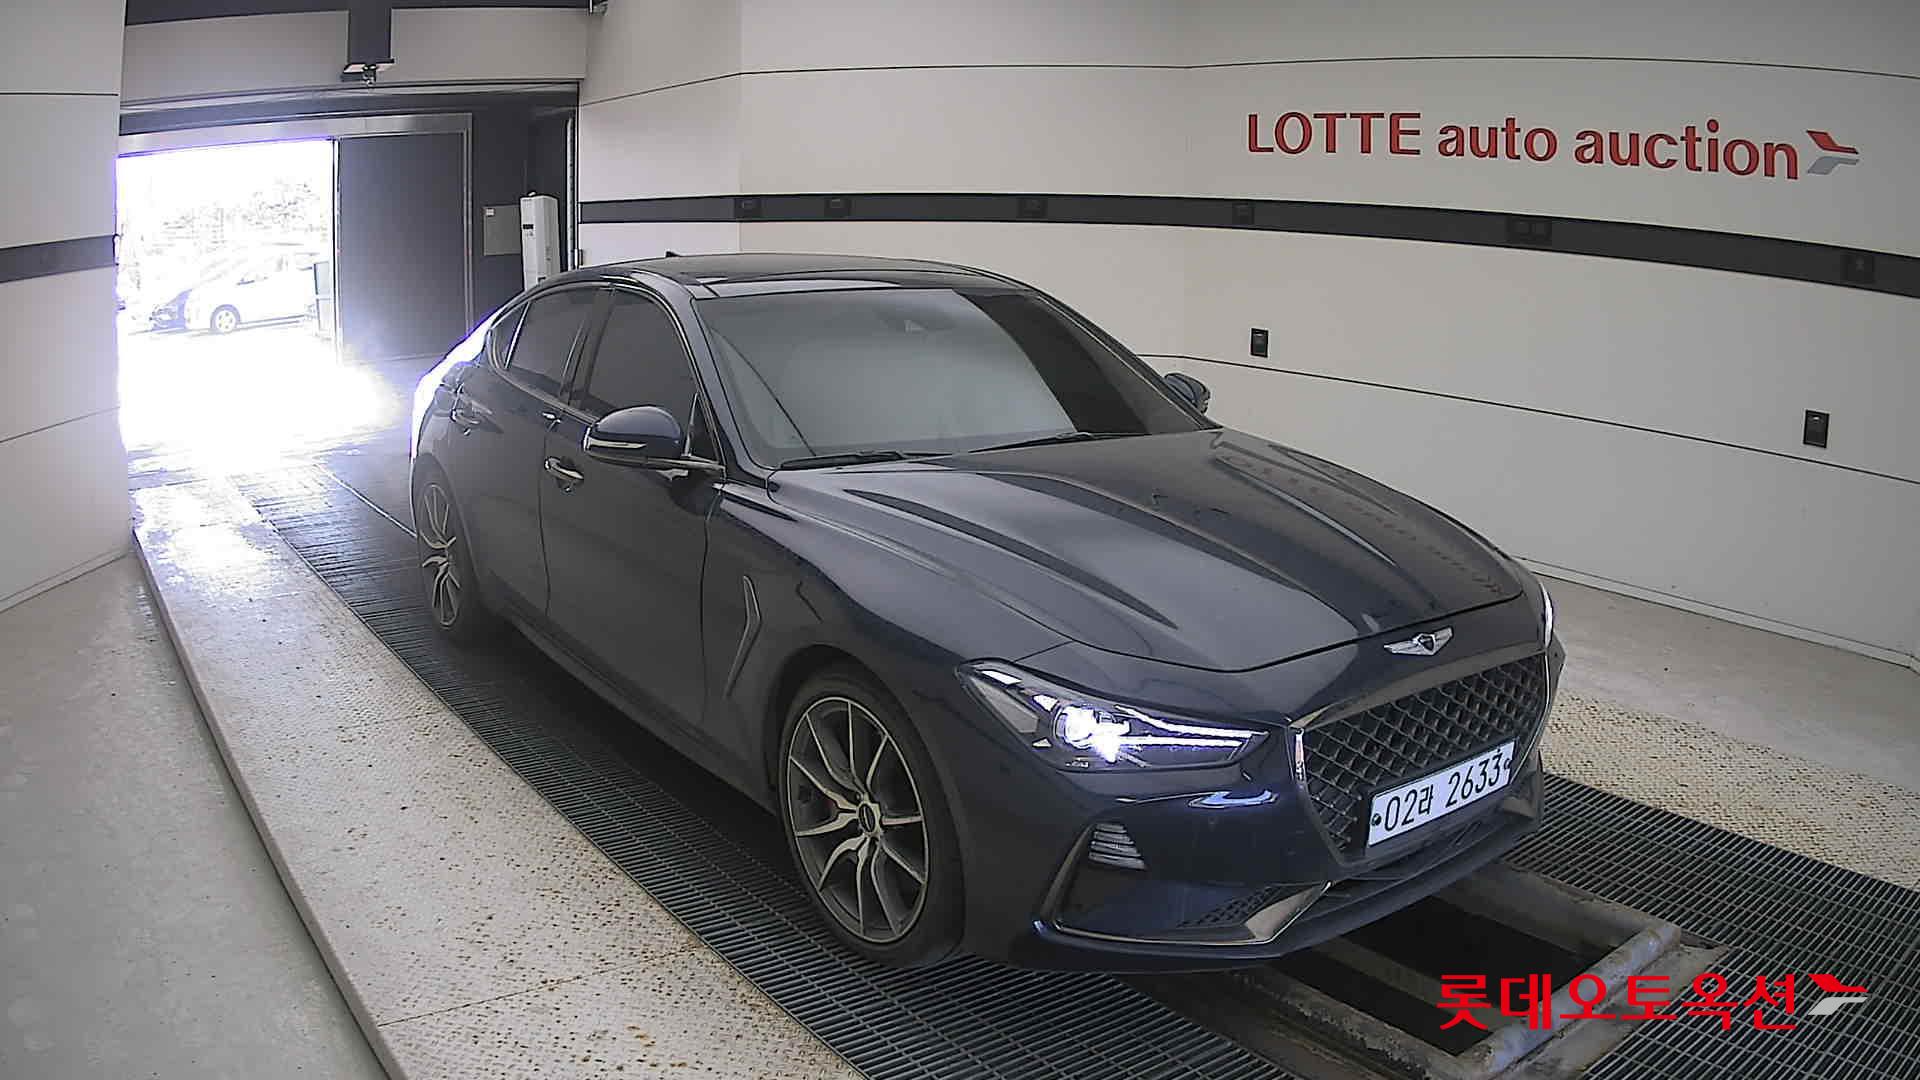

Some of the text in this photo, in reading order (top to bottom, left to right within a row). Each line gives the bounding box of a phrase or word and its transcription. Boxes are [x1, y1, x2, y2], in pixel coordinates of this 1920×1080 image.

[1248, 112, 1799, 179] LOTTE auto auction
[1384, 752, 1503, 831] 02라 2633
